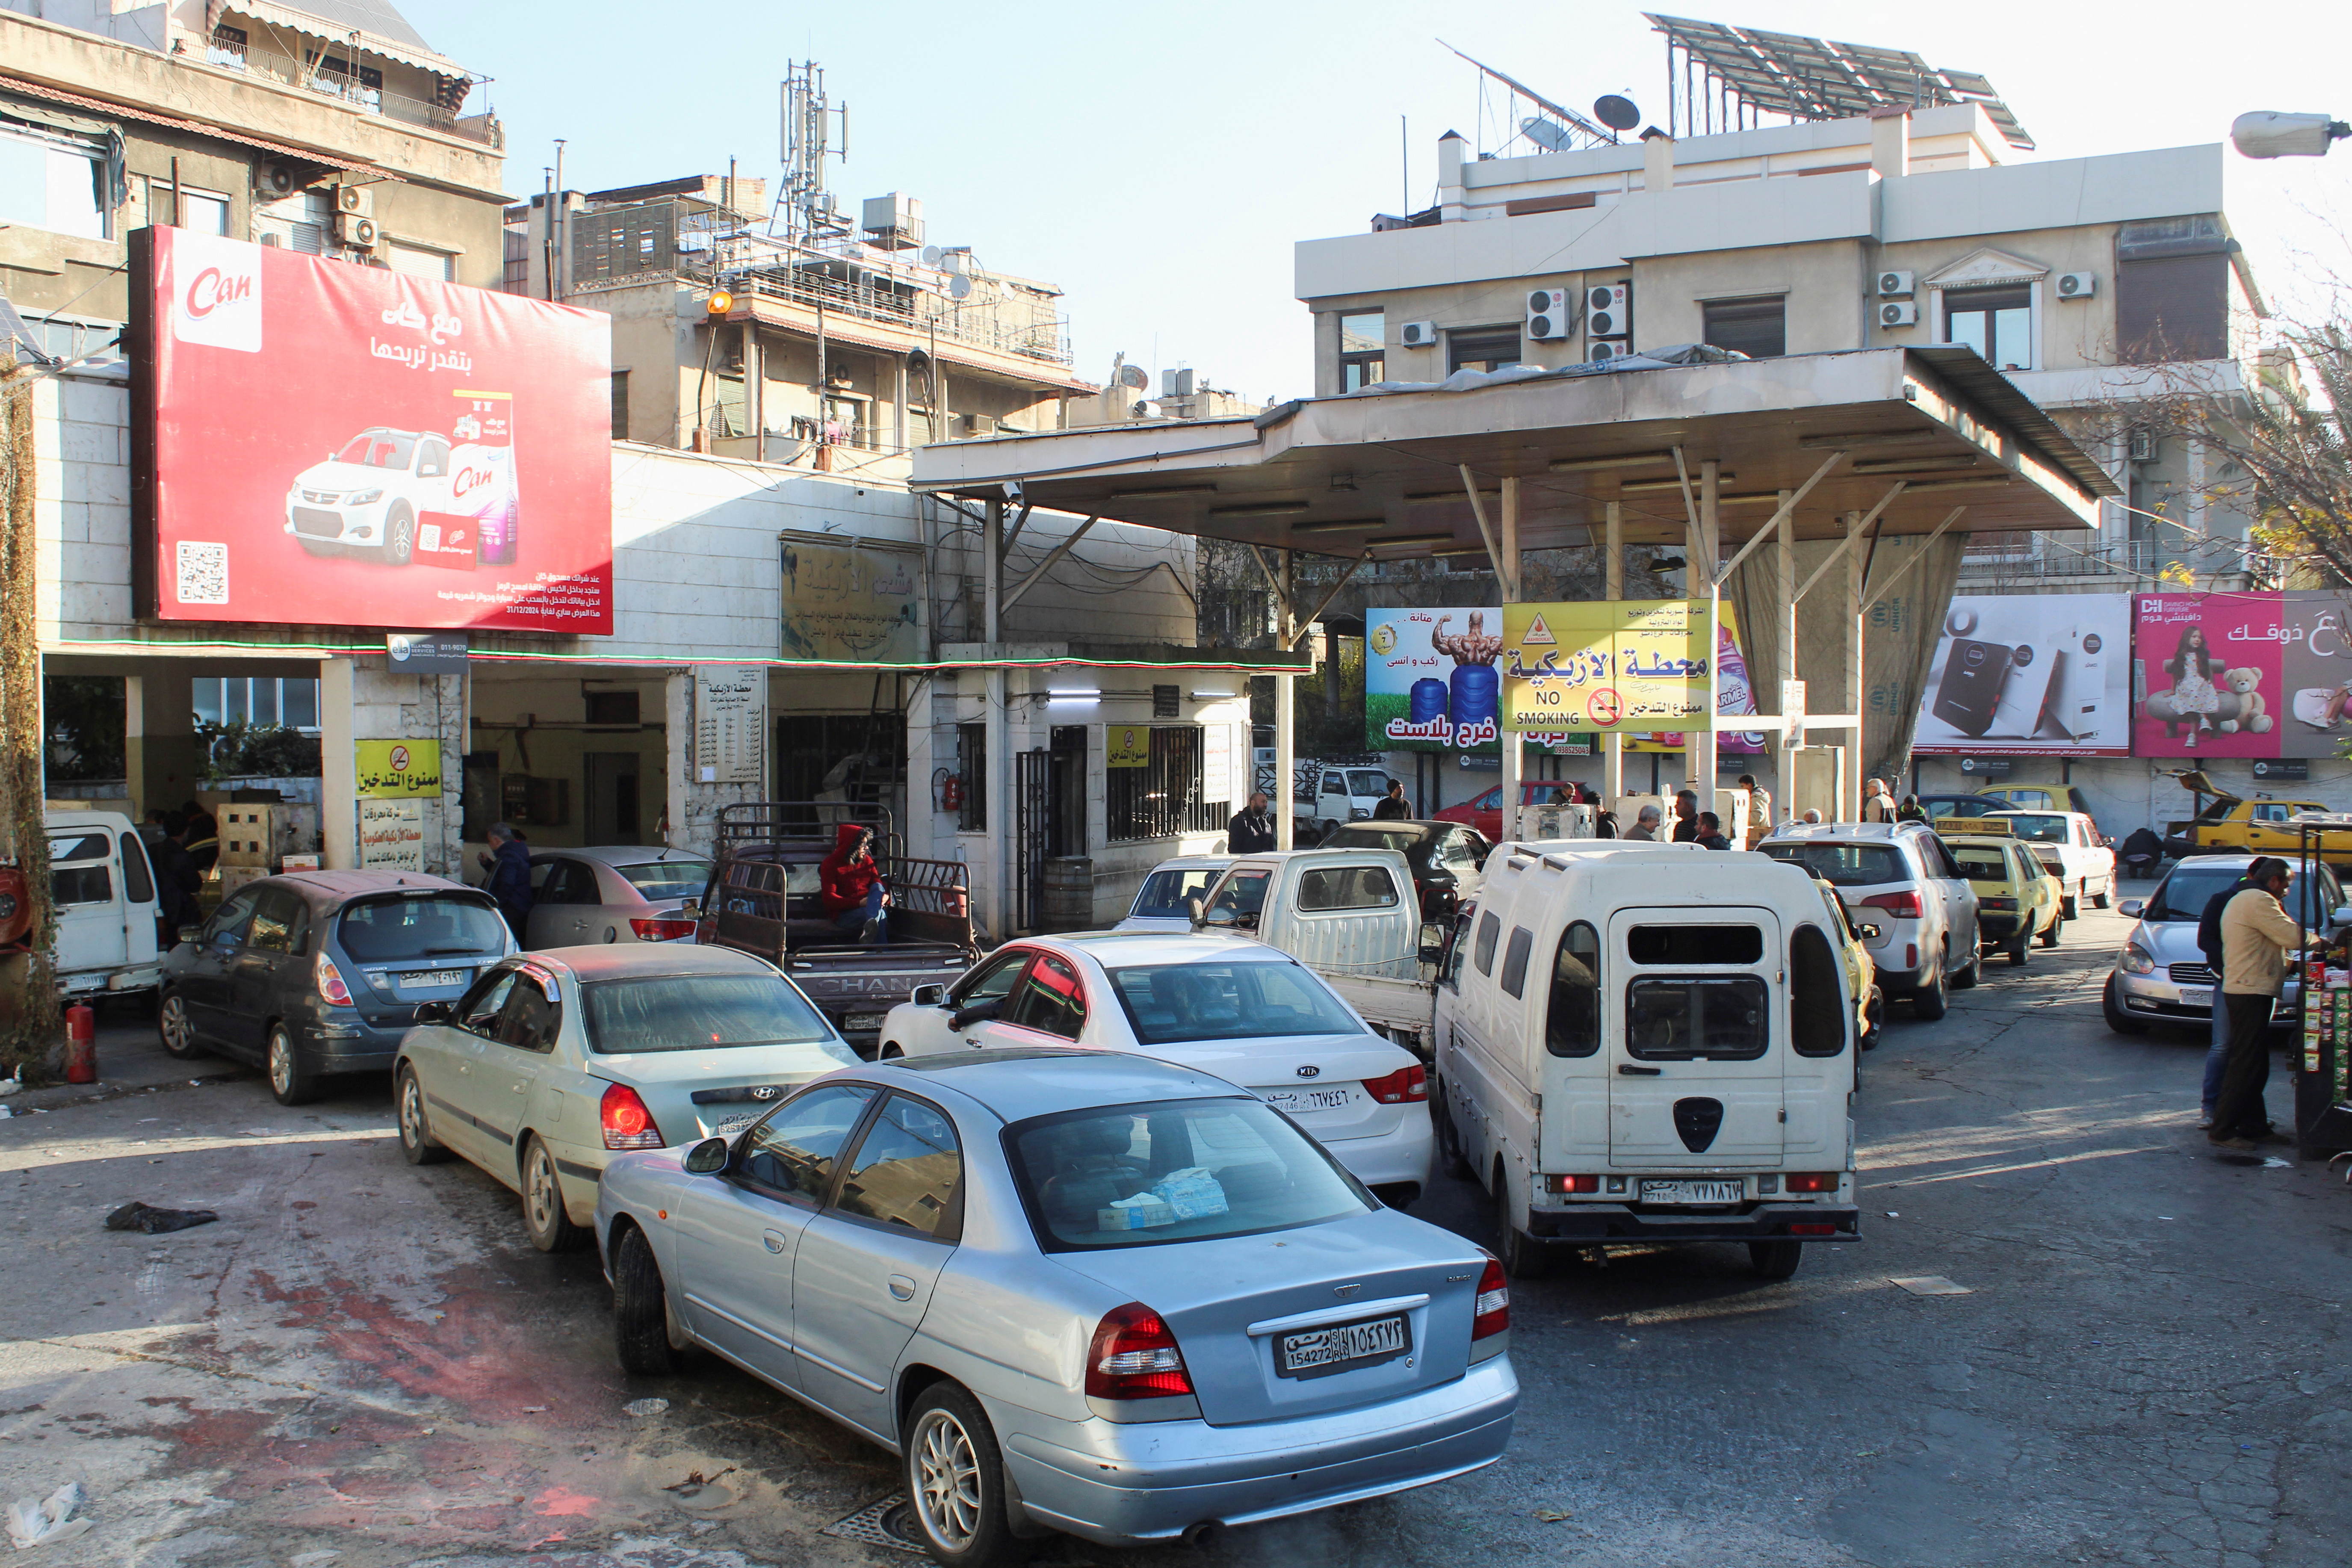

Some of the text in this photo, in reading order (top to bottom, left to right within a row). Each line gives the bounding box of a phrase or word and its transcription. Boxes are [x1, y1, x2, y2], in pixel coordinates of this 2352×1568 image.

[186, 267, 250, 318] Can
[382, 302, 462, 345] مع كان
[370, 337, 472, 376] بتقدر تربحها
[453, 467, 492, 498] Can
[536, 572, 547, 581] كان
[547, 573, 571, 582] مسحوق
[496, 582, 510, 591] الرمز
[529, 583, 547, 593] بطاقة
[547, 585, 566, 594] الكيس
[567, 586, 583, 595] بداخل
[437, 591, 453, 600] قيمة
[476, 592, 495, 602] وجوائز
[496, 594, 513, 603] سيارة
[514, 595, 525, 604] على
[526, 596, 548, 604] بالسحب
[550, 596, 567, 605] لتدخل
[567, 597, 585, 606] بياناتك
[586, 599, 600, 607] ادخل
[2142, 599, 2162, 613] DH
[506, 605, 539, 614] 31/12/2024
[541, 608, 555, 616] لغاية
[556, 608, 571, 619] ساري
[571, 609, 590, 618] العرض
[1628, 609, 1645, 617] وتوزيع
[1666, 608, 1686, 616] السورية
[1688, 607, 1705, 615] الشركة
[1409, 613, 1433, 623] متانة
[1649, 619, 1671, 627] البترولية
[2141, 612, 2201, 625] دافينشي هوم
[392, 641, 409, 654] ella
[1420, 656, 1438, 667] ركب
[1507, 647, 1708, 687] محطة الأزبكية
[733, 684, 751, 692] محطة
[1536, 691, 1560, 705] NO
[1629, 701, 1702, 717] ممنوع التدخين
[1517, 712, 1579, 725] SMOKING
[1387, 716, 1452, 745] بلاست
[1457, 717, 1496, 745] فرح
[1554, 746, 1590, 754] 0938525043
[1108, 749, 1147, 763] ممنوع التدخين
[358, 772, 439, 792] ممنوع التدخين
[386, 806, 400, 820] شركة
[1268, 1093, 1297, 1102] دمشق
[1310, 1090, 1348, 1107] ٦٦٧٤٤٦
[1643, 1181, 1678, 1192] دمشق
[1693, 1183, 1741, 1200] ٧٧١٨٦٧
[1286, 1334, 1330, 1352] دمشق
[1350, 1320, 1401, 1354] ١٥٤٢٧٢
[1332, 1331, 1340, 1358] SYR
[1290, 1347, 1332, 1365] 154272
